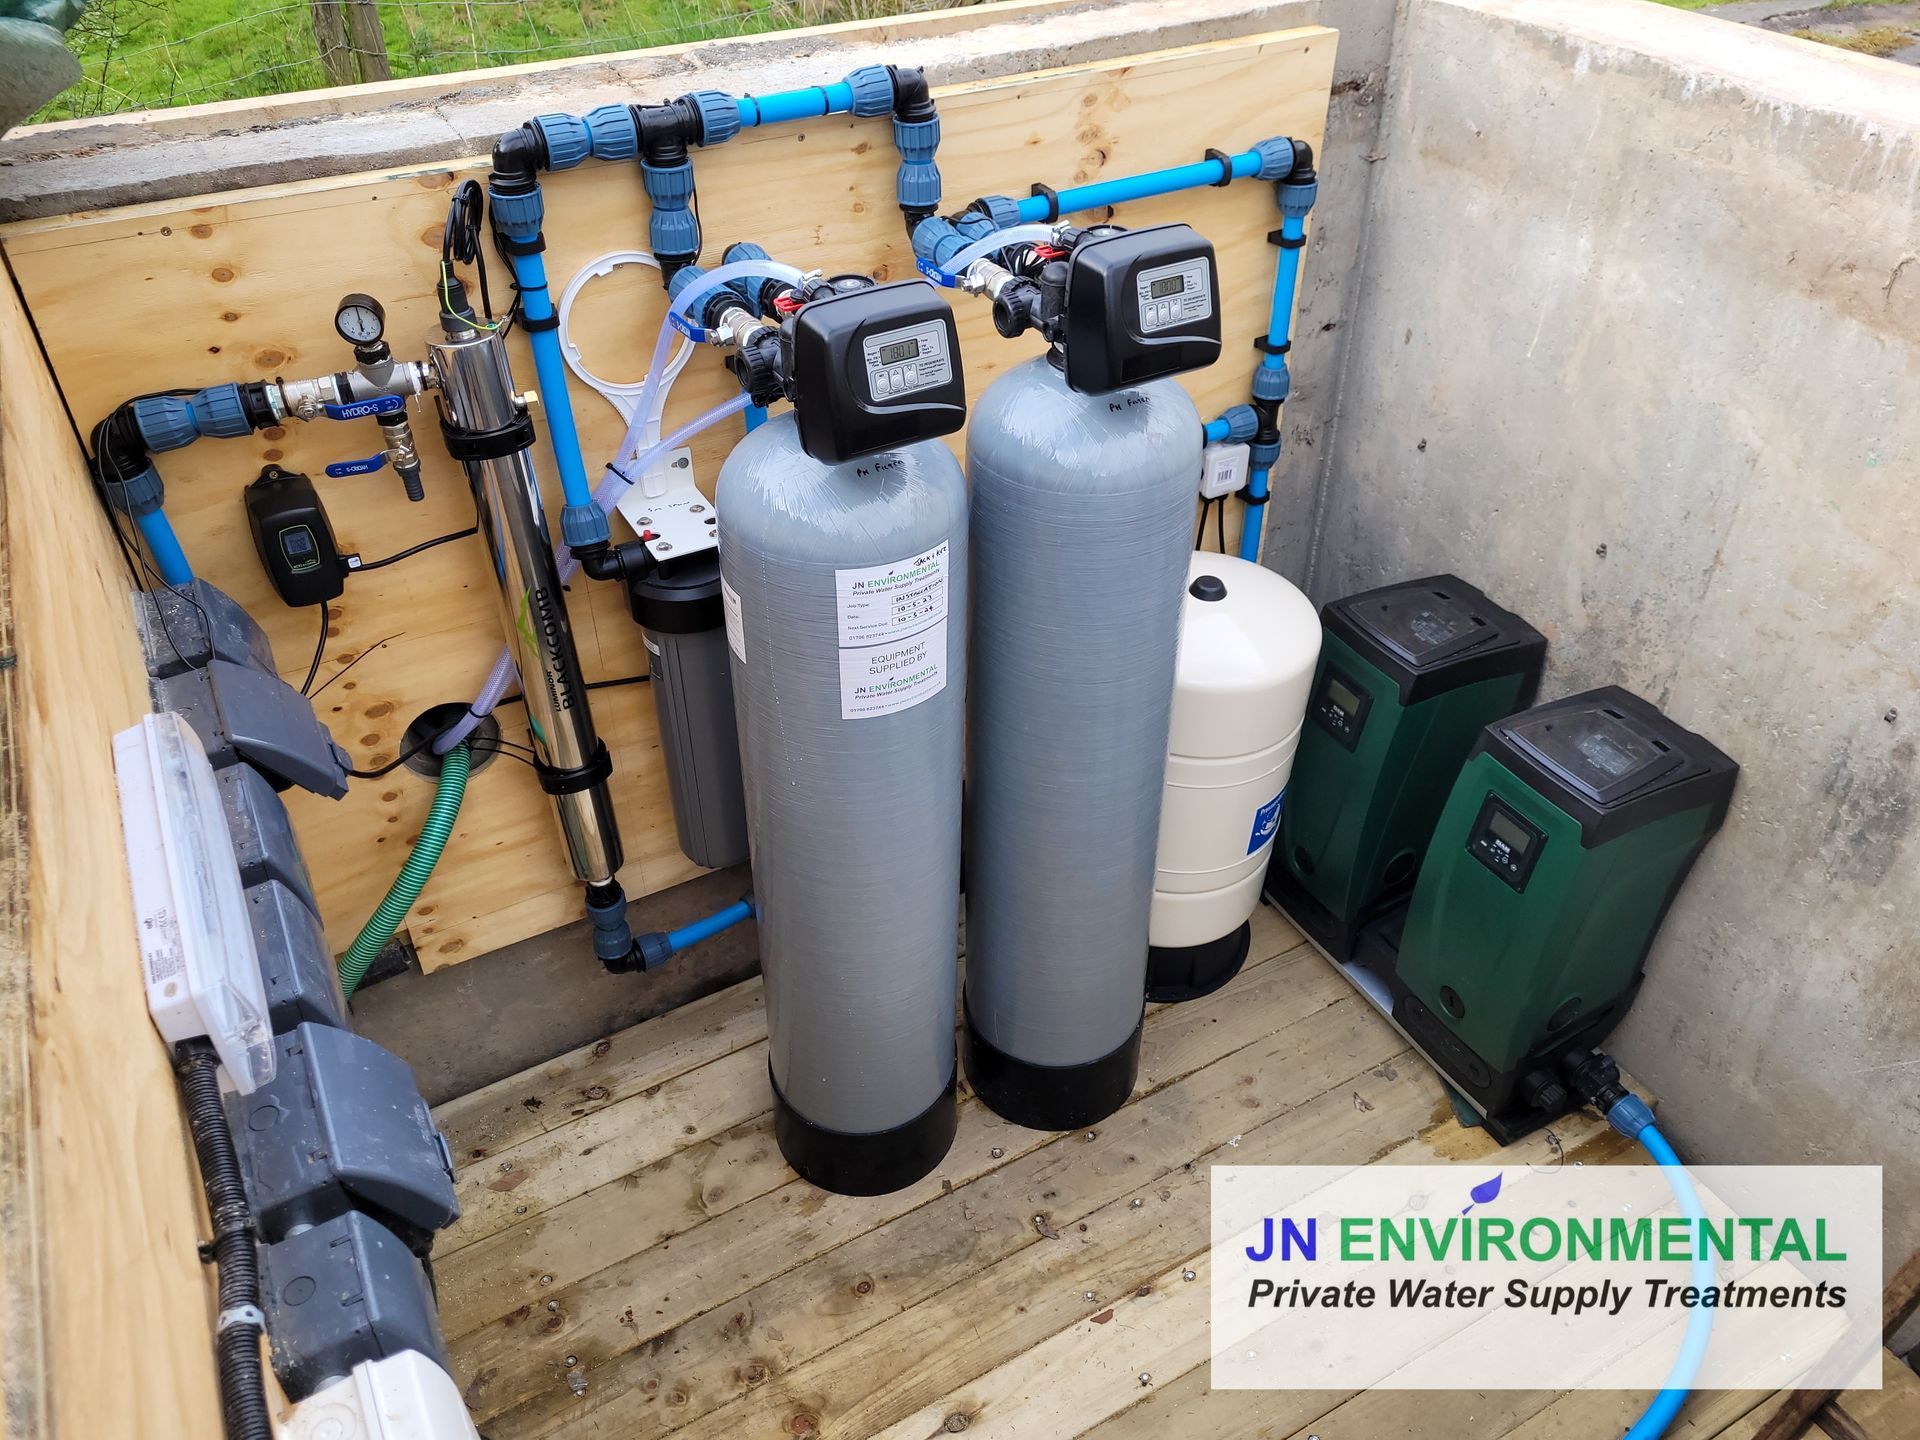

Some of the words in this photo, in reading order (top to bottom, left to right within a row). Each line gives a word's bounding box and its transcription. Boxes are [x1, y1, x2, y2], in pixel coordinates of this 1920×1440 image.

[890, 345, 911, 360] 1801
[342, 404, 379, 418] HYDRO-S
[867, 560, 940, 588] ENVIRONMENTAL
[876, 586, 893, 594] Water
[894, 580, 914, 589] Supply
[536, 586, 575, 710] BLACKCOMB
[871, 642, 926, 665] EQUIPMENT
[869, 656, 915, 675] SUPPLIED
[917, 650, 928, 662] BY
[868, 664, 938, 693] ENVIRONMENTAL
[546, 670, 561, 712] LUMINOR
[854, 692, 876, 700] Private
[876, 689, 893, 697] Water
[894, 684, 912, 693] Supply
